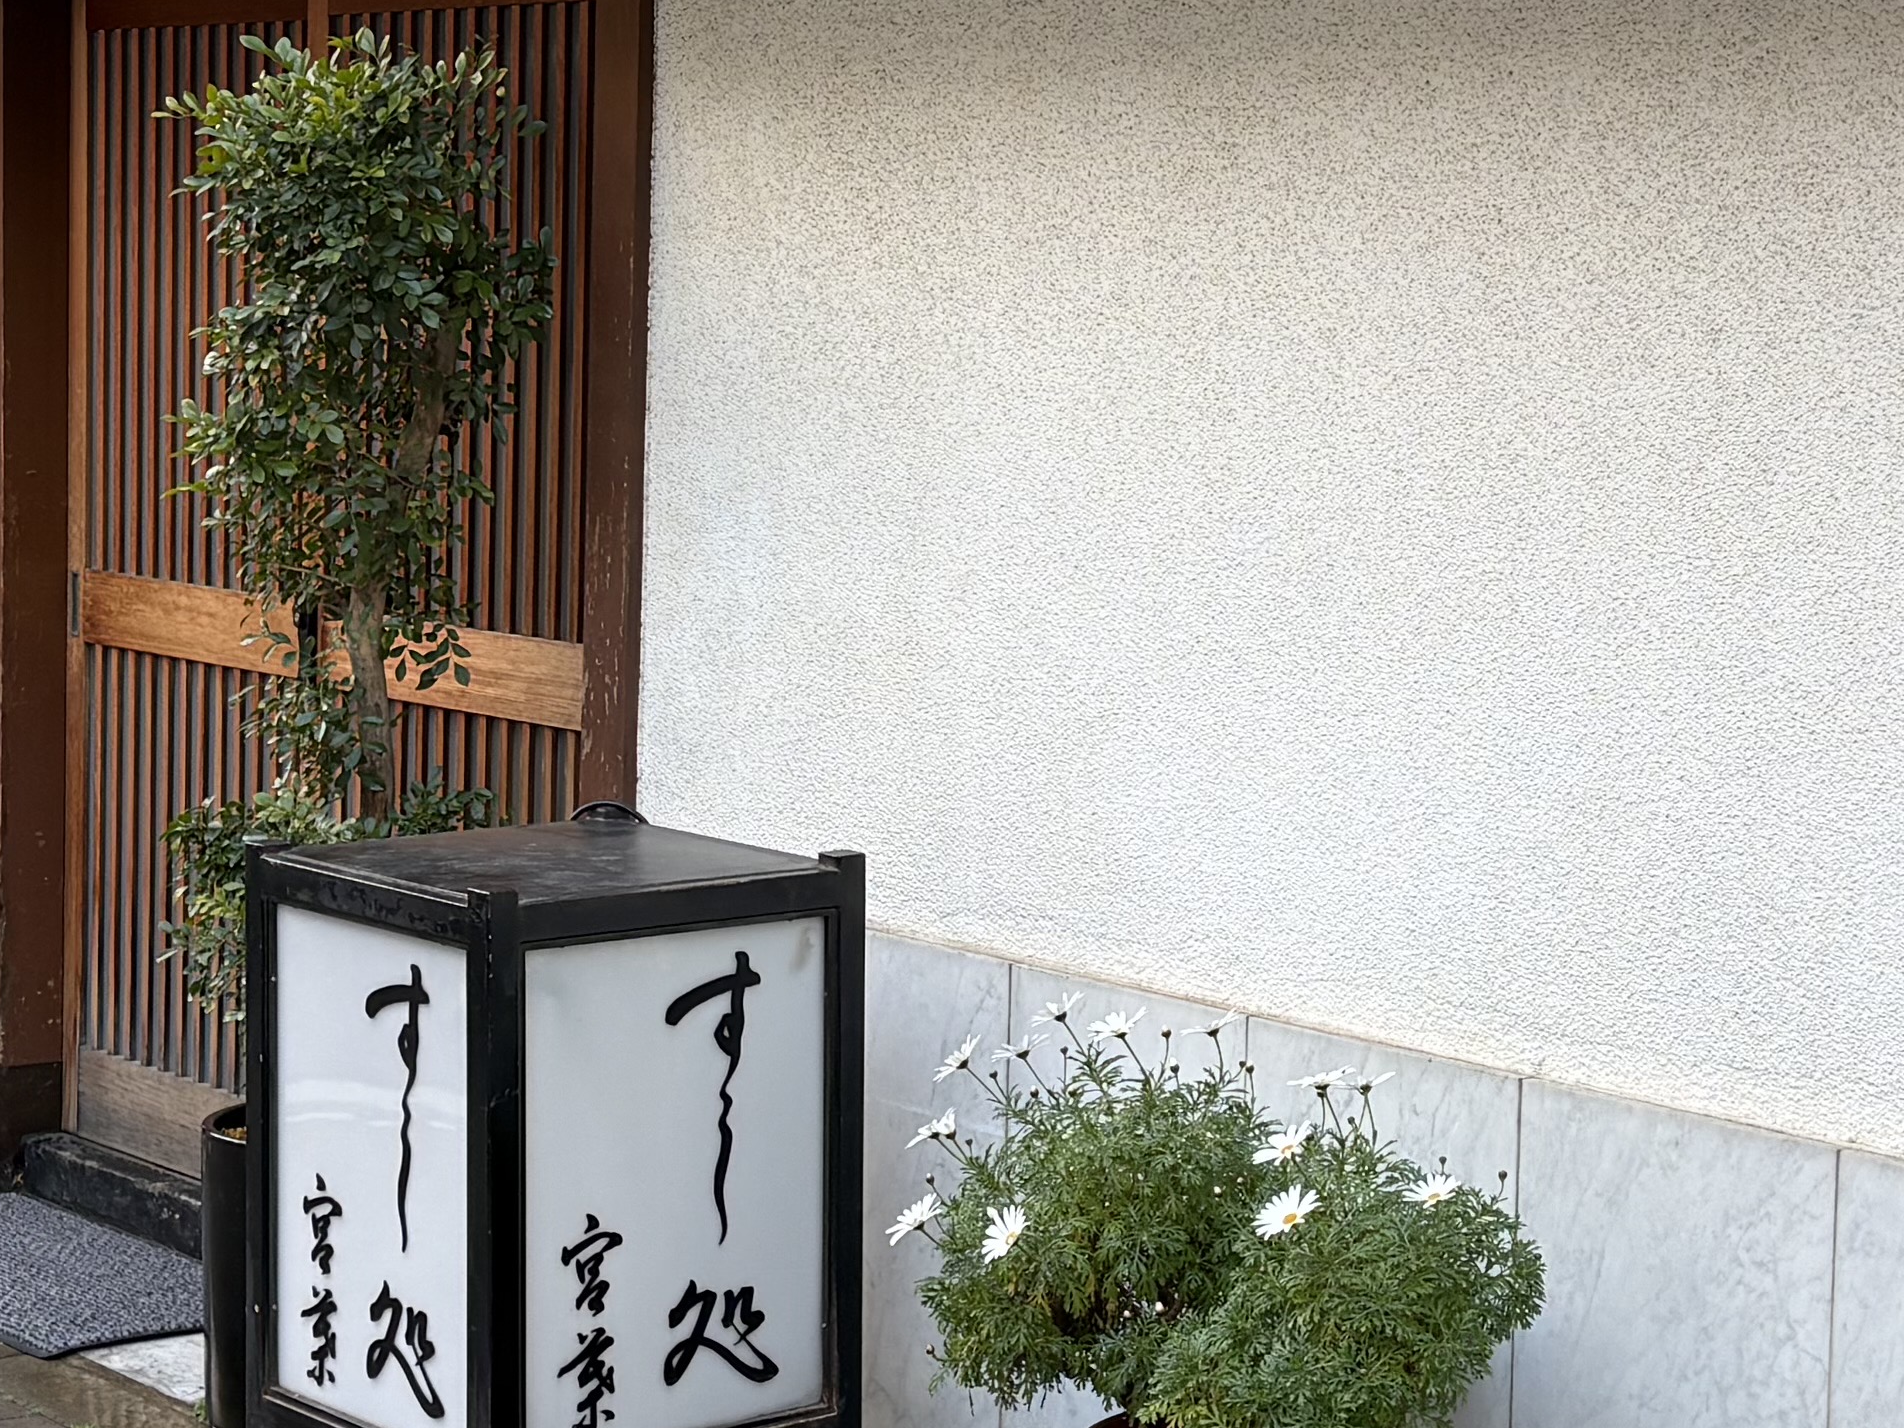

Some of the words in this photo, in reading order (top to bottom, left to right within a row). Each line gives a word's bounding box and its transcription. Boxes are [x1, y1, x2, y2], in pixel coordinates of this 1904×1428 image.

[365, 963, 445, 1419] すし処
[664, 951, 779, 1386] すし処
